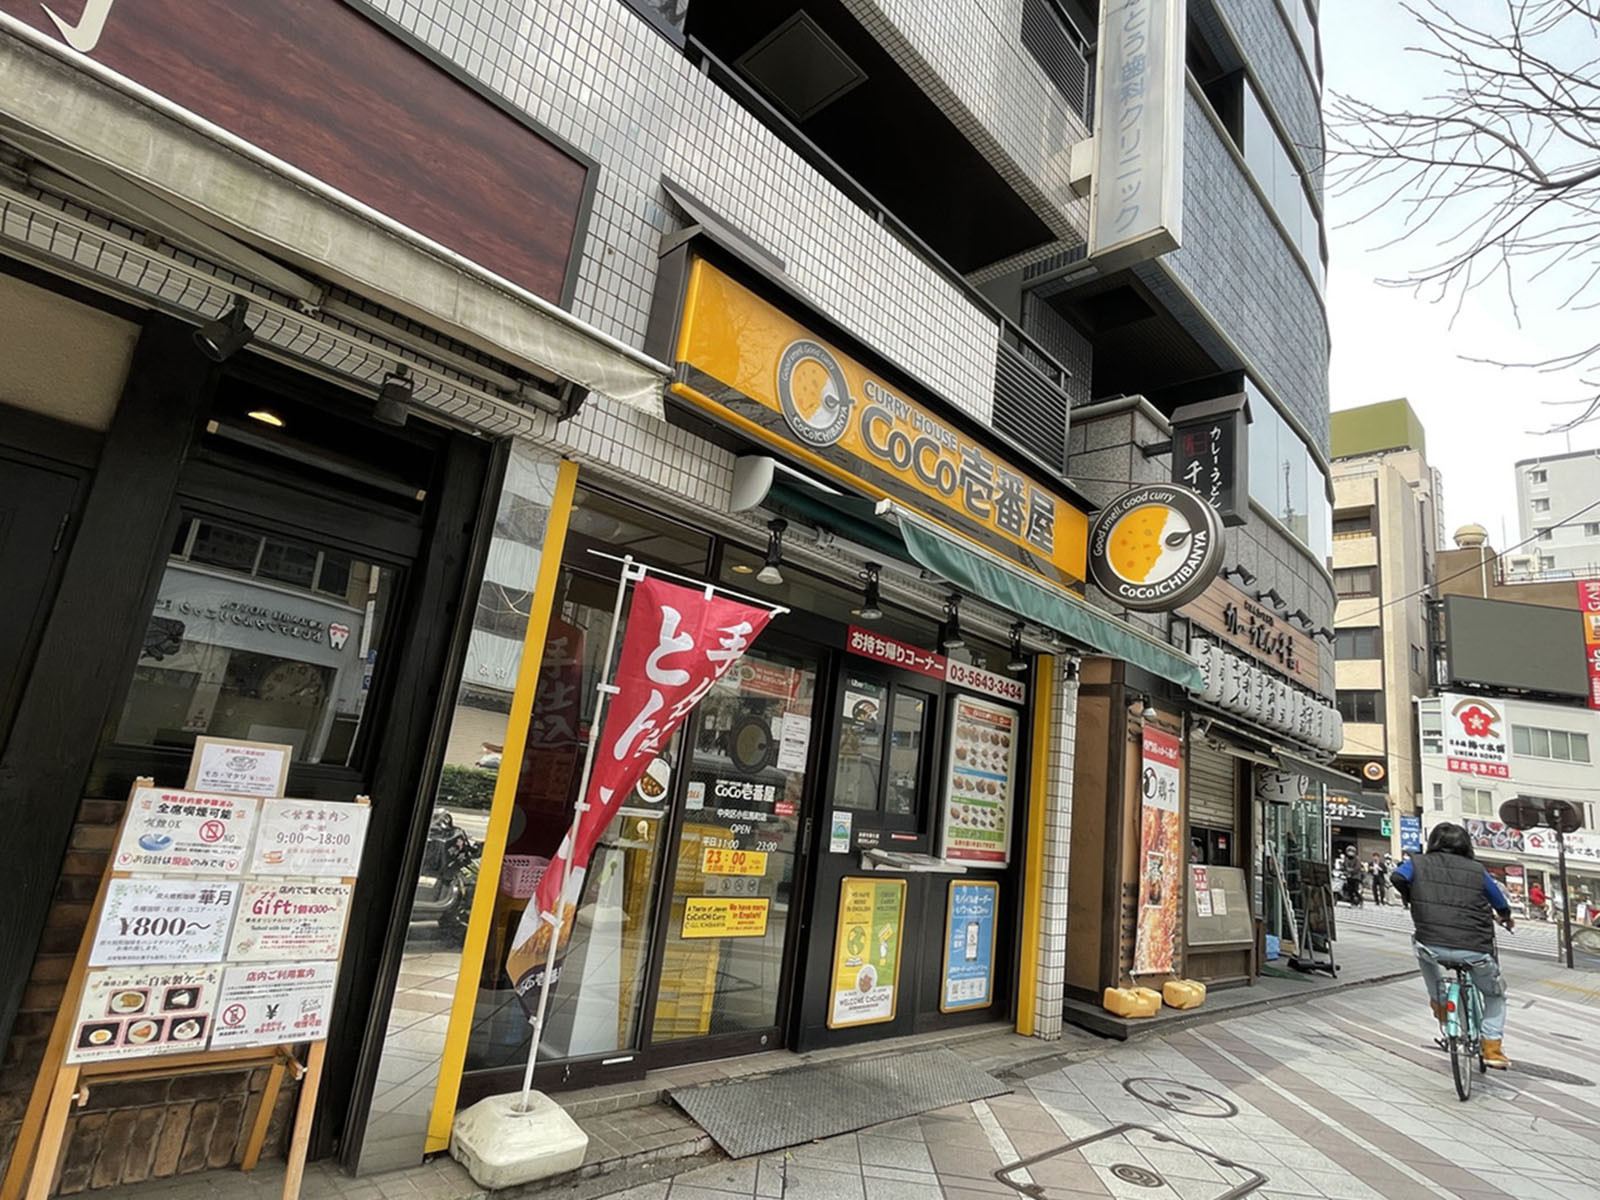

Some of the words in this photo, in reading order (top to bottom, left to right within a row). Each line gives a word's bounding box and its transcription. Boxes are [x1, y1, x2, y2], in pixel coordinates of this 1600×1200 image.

[864, 380, 912, 421] CURRY
[913, 408, 958, 452] HOUSE
[1209, 426, 1222, 508] カレーうどん
[860, 403, 1056, 556] CoCo壱番屋
[1093, 529, 1105, 557] Good
[1103, 505, 1124, 531] smell.
[1122, 490, 1149, 510] Good
[1149, 491, 1176, 504] curry
[1119, 530, 1207, 599] CoCoICHIBANYA
[851, 632, 945, 671] お持ち帰りコーナー
[951, 665, 1023, 699] 03-5643-3434
[715, 783, 775, 803] CoCo壱番屋
[156, 803, 233, 820] 全席喫煙可能
[729, 823, 752, 835] OPEN
[703, 837, 717, 847] 平日
[718, 839, 740, 850] 11:00
[755, 841, 777, 852] 23:00
[198, 889, 233, 907] 華月
[279, 885, 349, 897] 店内でご覧ください。
[252, 899, 292, 915] Gift
[246, 968, 316, 983] 店内ご利用案内
